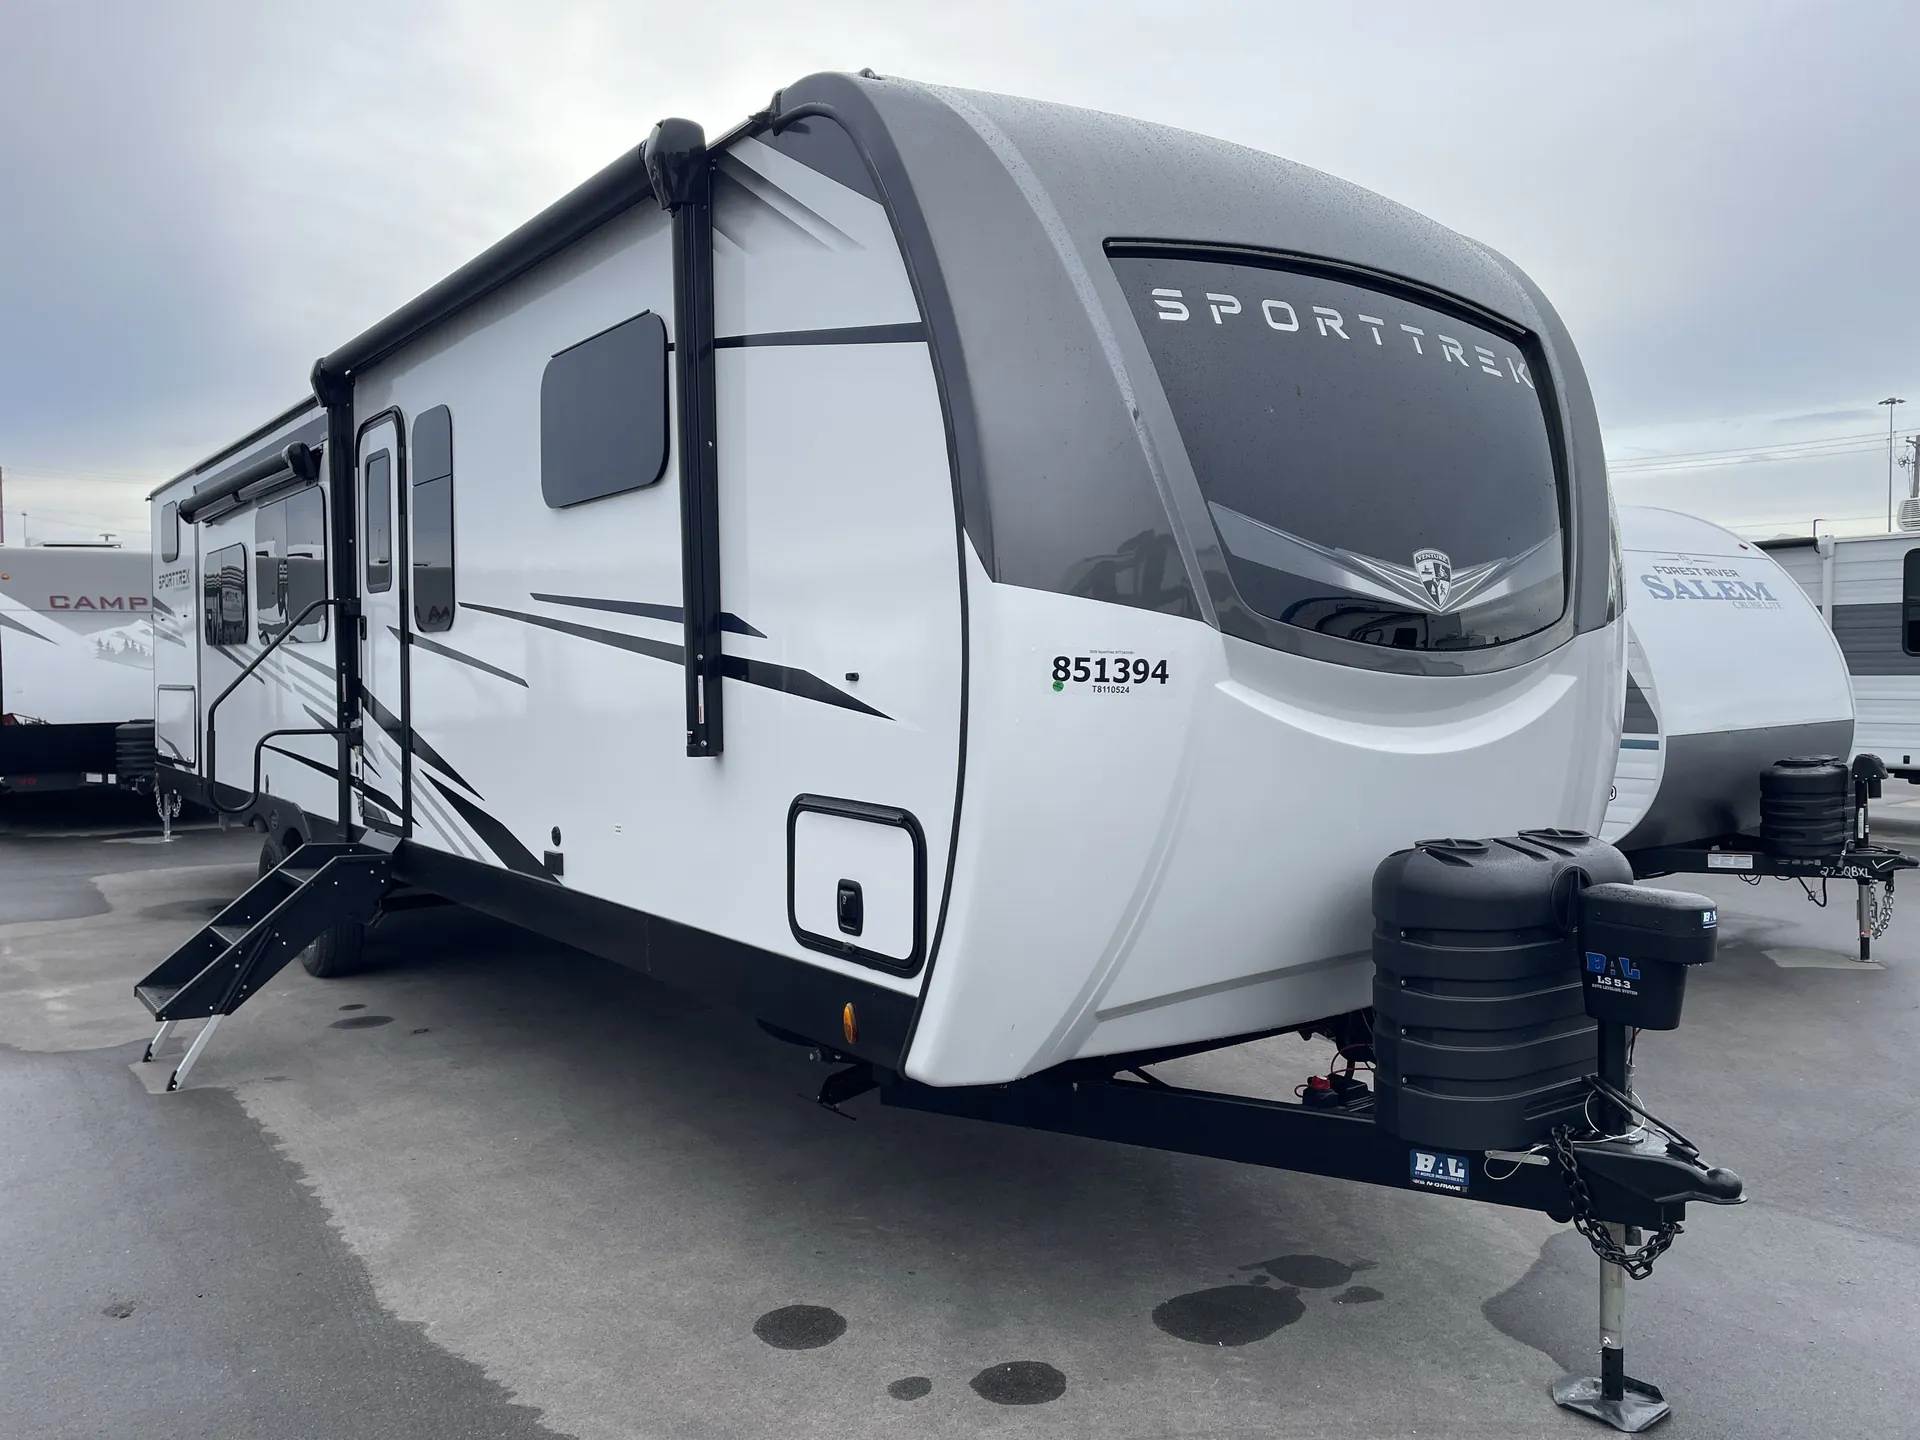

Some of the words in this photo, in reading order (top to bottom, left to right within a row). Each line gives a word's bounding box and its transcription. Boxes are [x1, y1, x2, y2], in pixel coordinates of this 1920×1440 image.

[1151, 288, 1535, 390] SPORTTREK
[158, 569, 190, 589] SPORTTREK
[1652, 565, 1702, 576] FOREST
[1704, 568, 1740, 578] RIVER
[1640, 574, 1778, 601] SALEM
[1052, 656, 1170, 684] 851394
[1092, 685, 1130, 694] T8110524
[1597, 975, 1612, 985] LS
[1415, 1152, 1465, 1178] BAL
